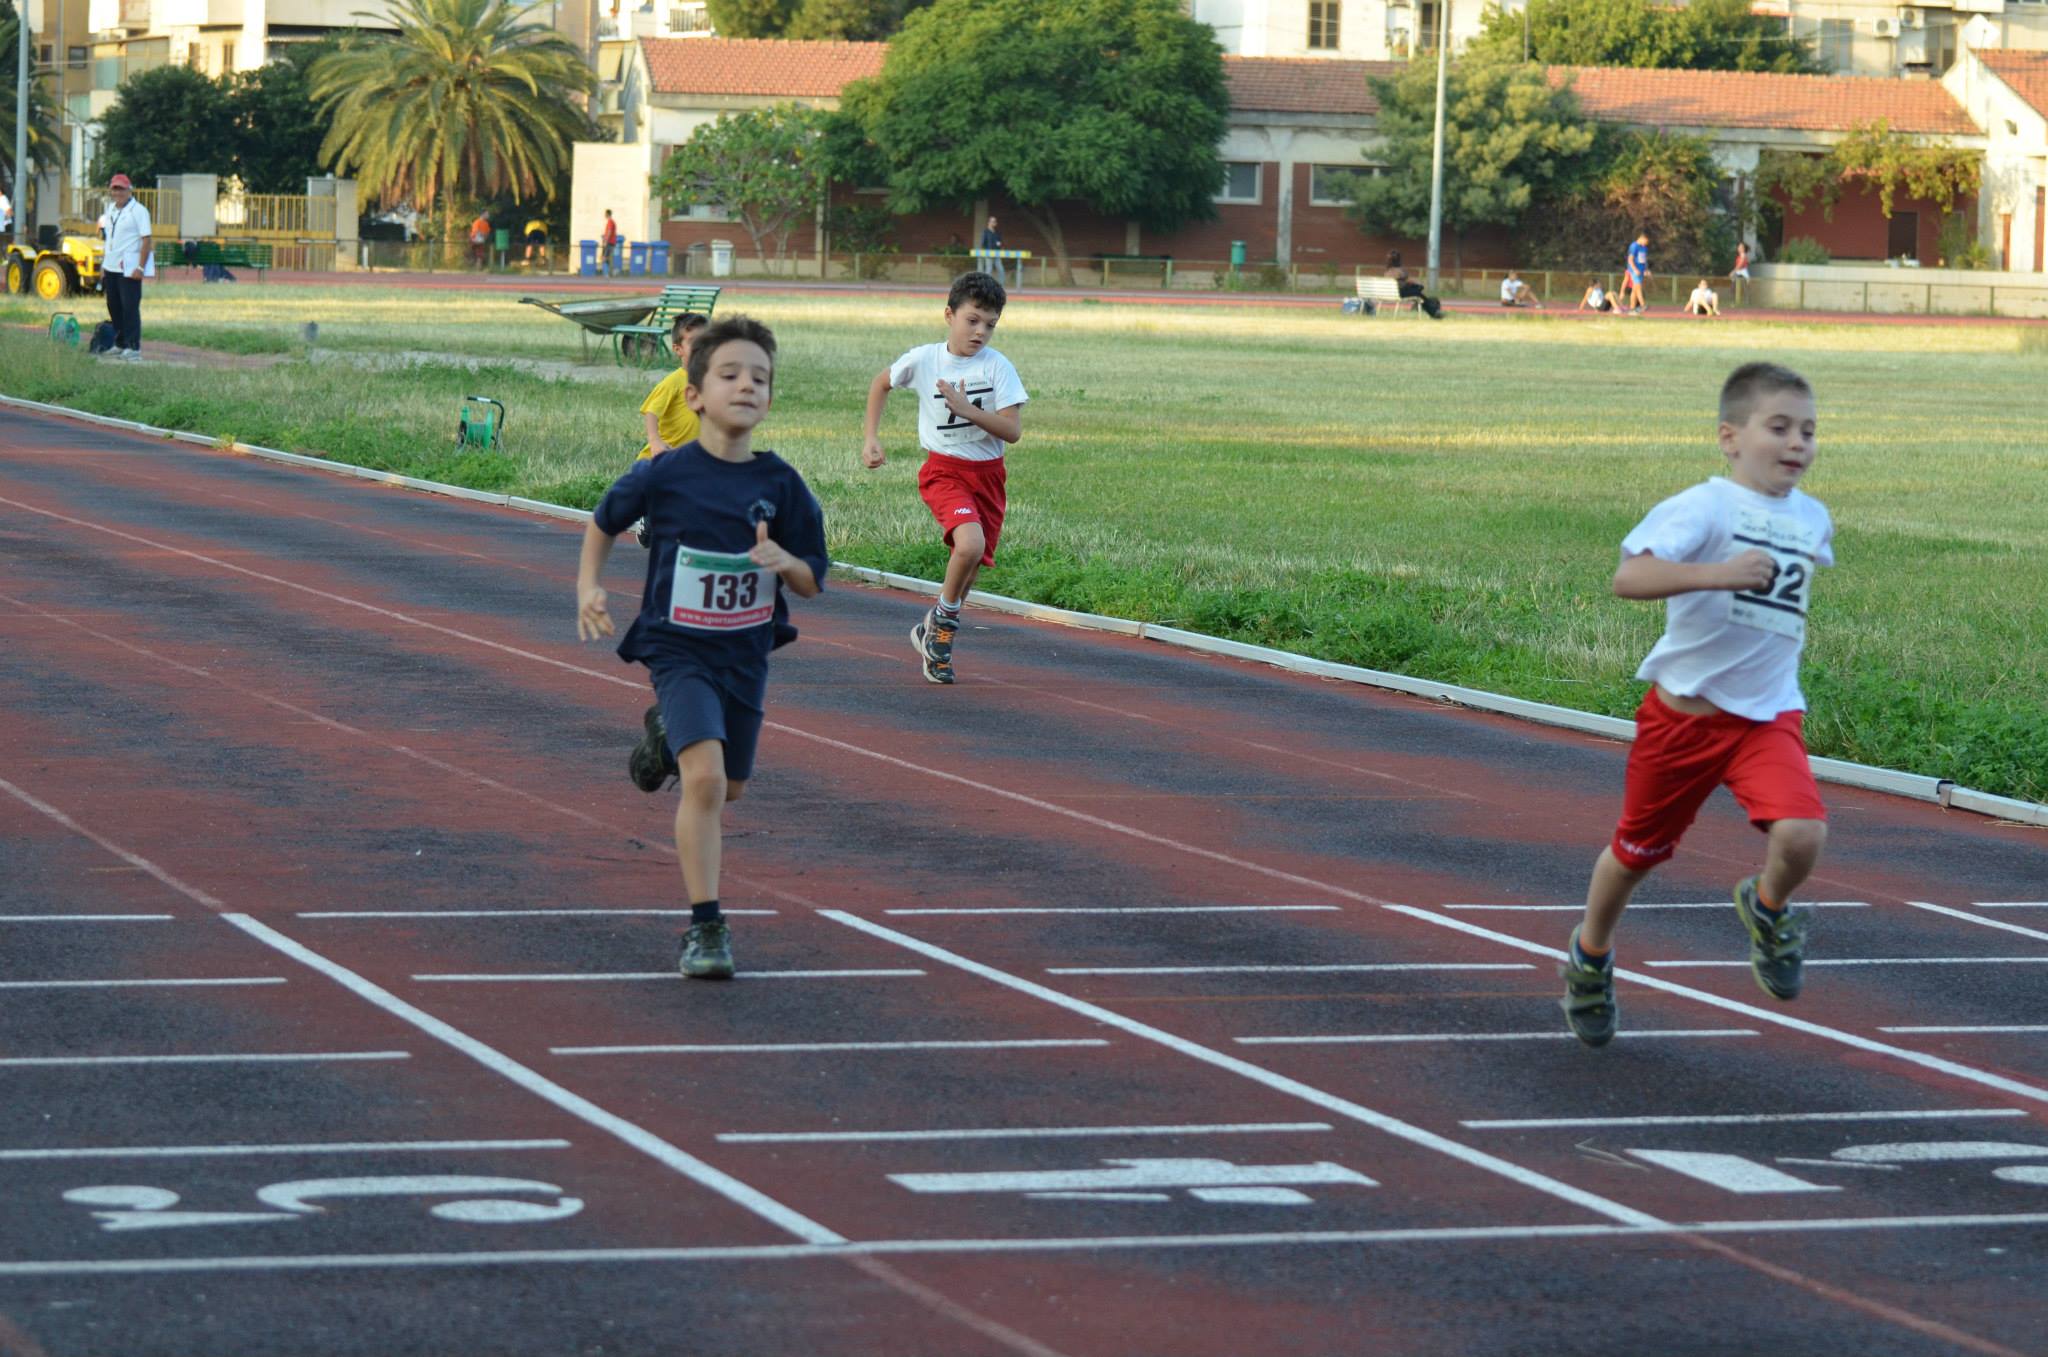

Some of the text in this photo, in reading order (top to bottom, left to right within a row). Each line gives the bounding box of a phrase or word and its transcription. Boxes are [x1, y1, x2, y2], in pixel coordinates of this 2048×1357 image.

[699, 572, 759, 611] 133
[62, 1175, 584, 1231] 5
[885, 1157, 1382, 1205] 4
